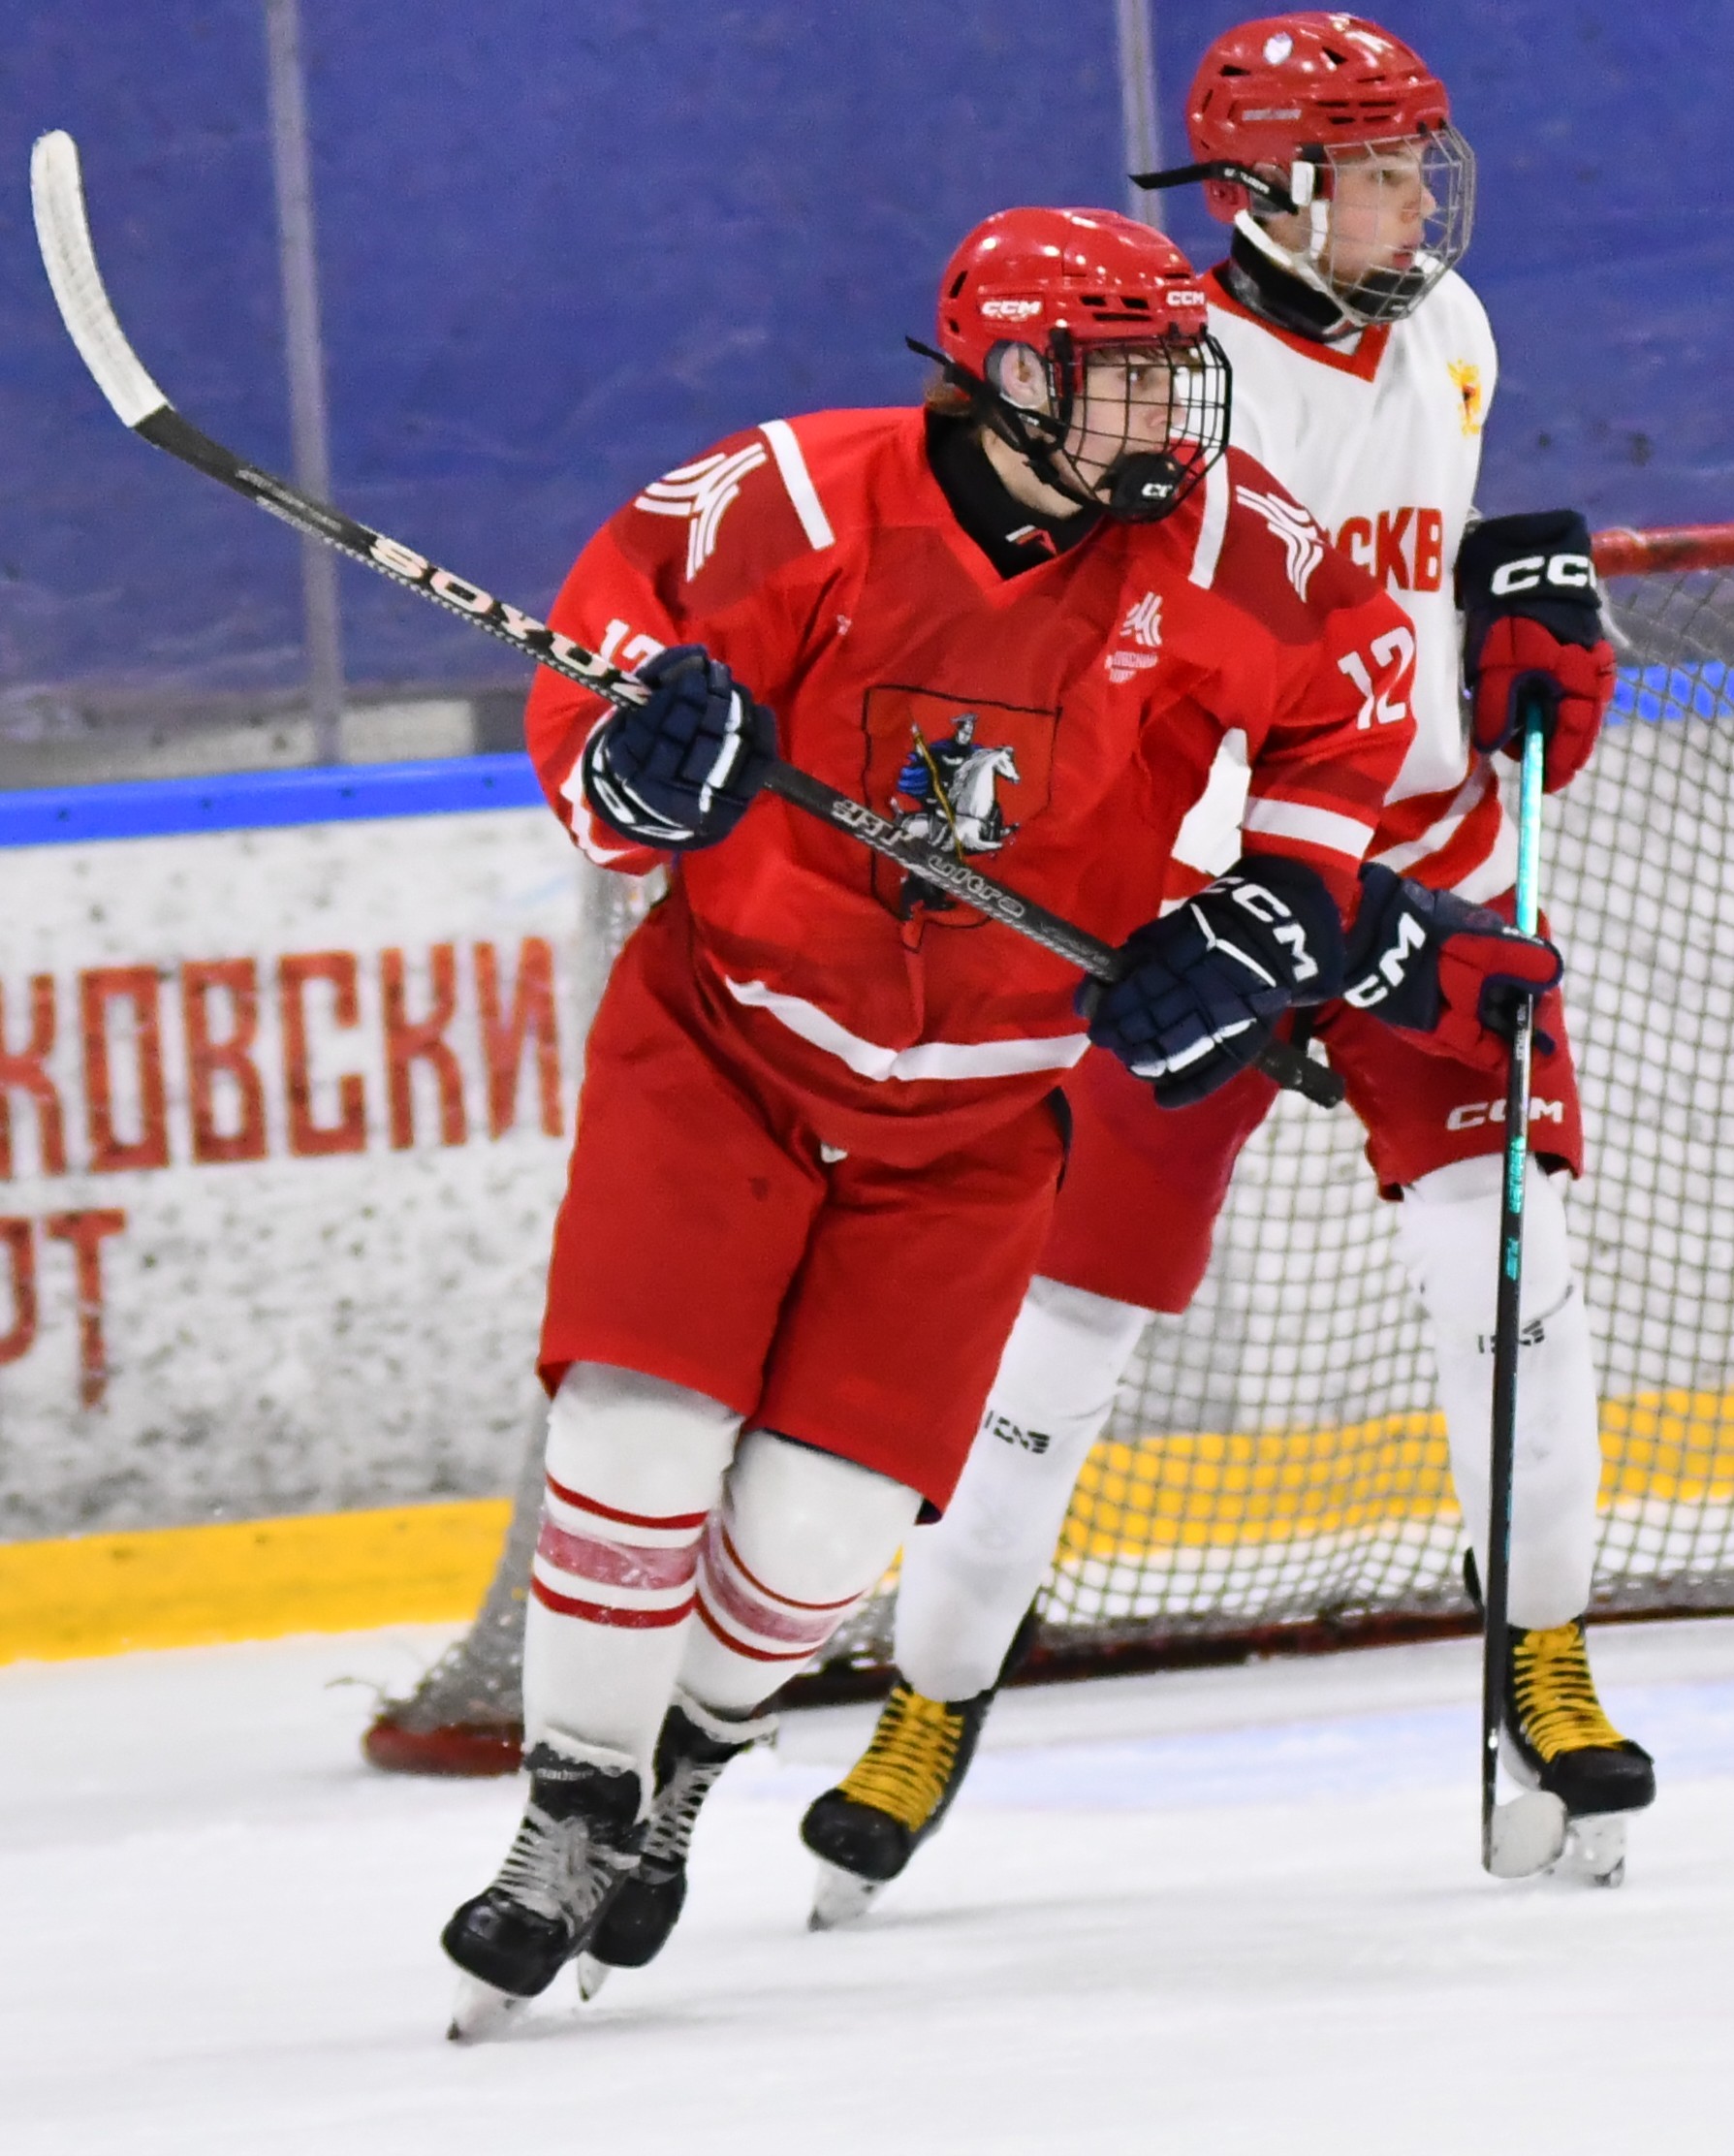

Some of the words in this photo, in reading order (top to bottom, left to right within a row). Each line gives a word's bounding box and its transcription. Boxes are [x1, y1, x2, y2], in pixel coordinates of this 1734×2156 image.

[981, 300, 1042, 316] CCM
[1167, 290, 1205, 306] CCM
[1490, 554, 1597, 595] CC
[369, 536, 652, 707] SOYUZ
[1337, 625, 1415, 730] 12
[1342, 911, 1428, 1008] CM
